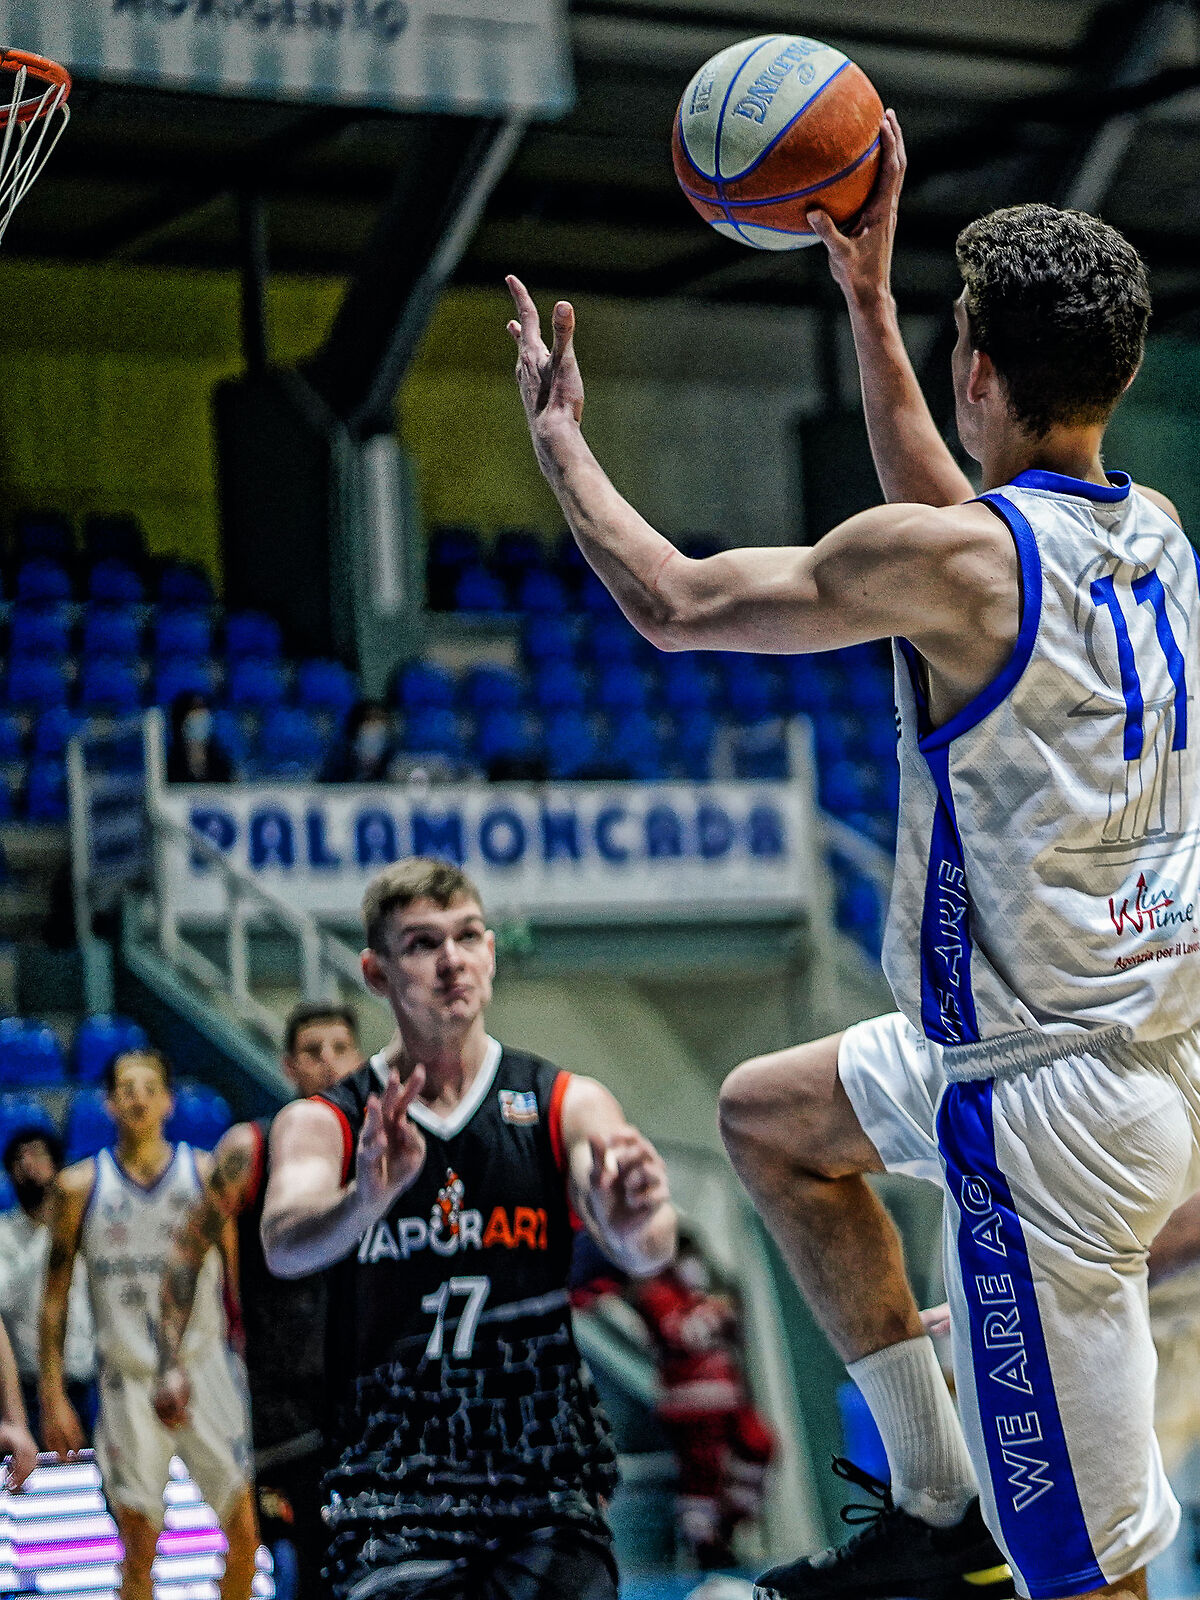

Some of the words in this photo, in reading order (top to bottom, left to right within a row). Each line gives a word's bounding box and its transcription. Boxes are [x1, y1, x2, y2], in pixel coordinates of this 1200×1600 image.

[1091, 569, 1188, 761] 11
[1156, 947, 1174, 962] per
[961, 1175, 1008, 1257] AG
[421, 1275, 491, 1361] 17
[975, 1274, 1034, 1396] ARE
[996, 1411, 1055, 1512] WE
